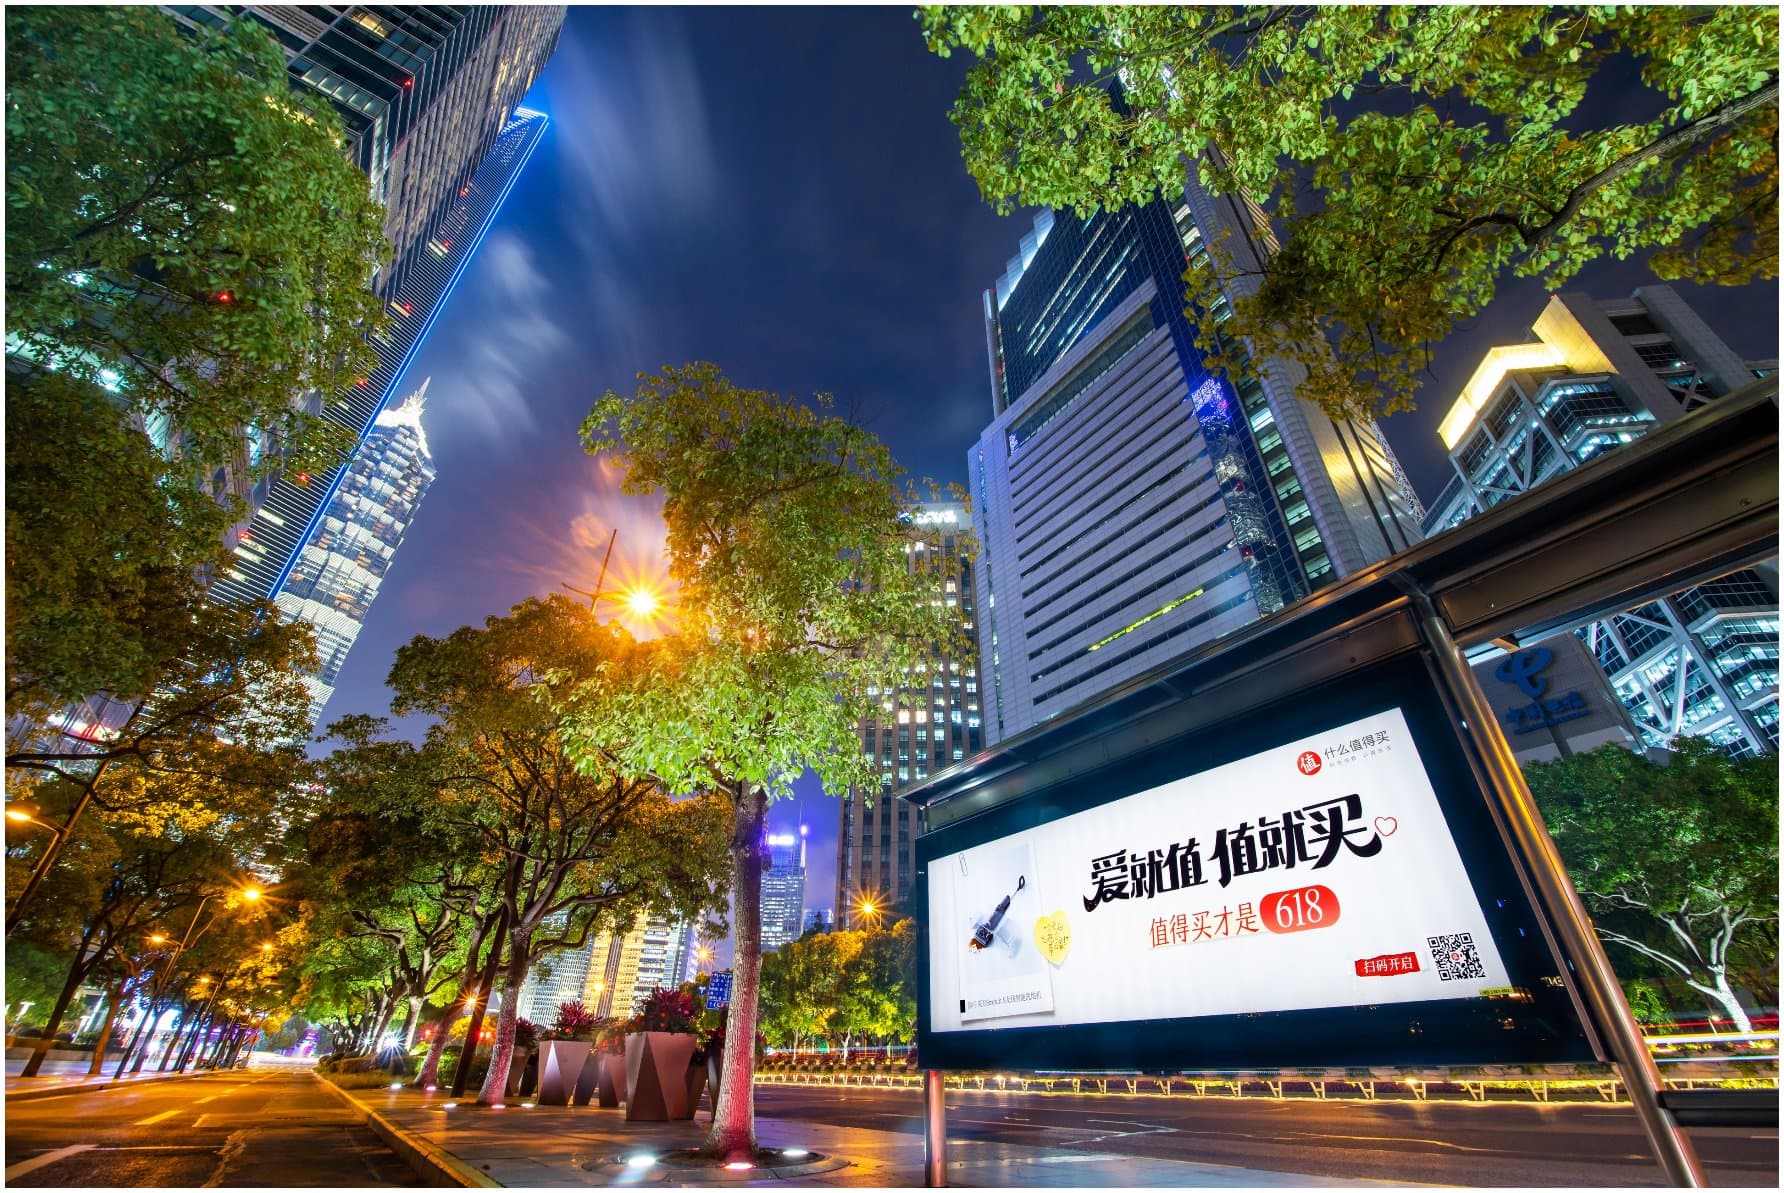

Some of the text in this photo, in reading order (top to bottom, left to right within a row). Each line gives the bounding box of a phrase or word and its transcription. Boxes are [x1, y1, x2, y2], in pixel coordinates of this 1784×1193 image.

[1300, 753, 1321, 774] 值
[1324, 730, 1390, 759] 什么值得买
[1083, 794, 1383, 912] 爱就值 值就买
[1149, 888, 1323, 948] 值得买才是 618
[1363, 955, 1413, 974] 扫码开启
